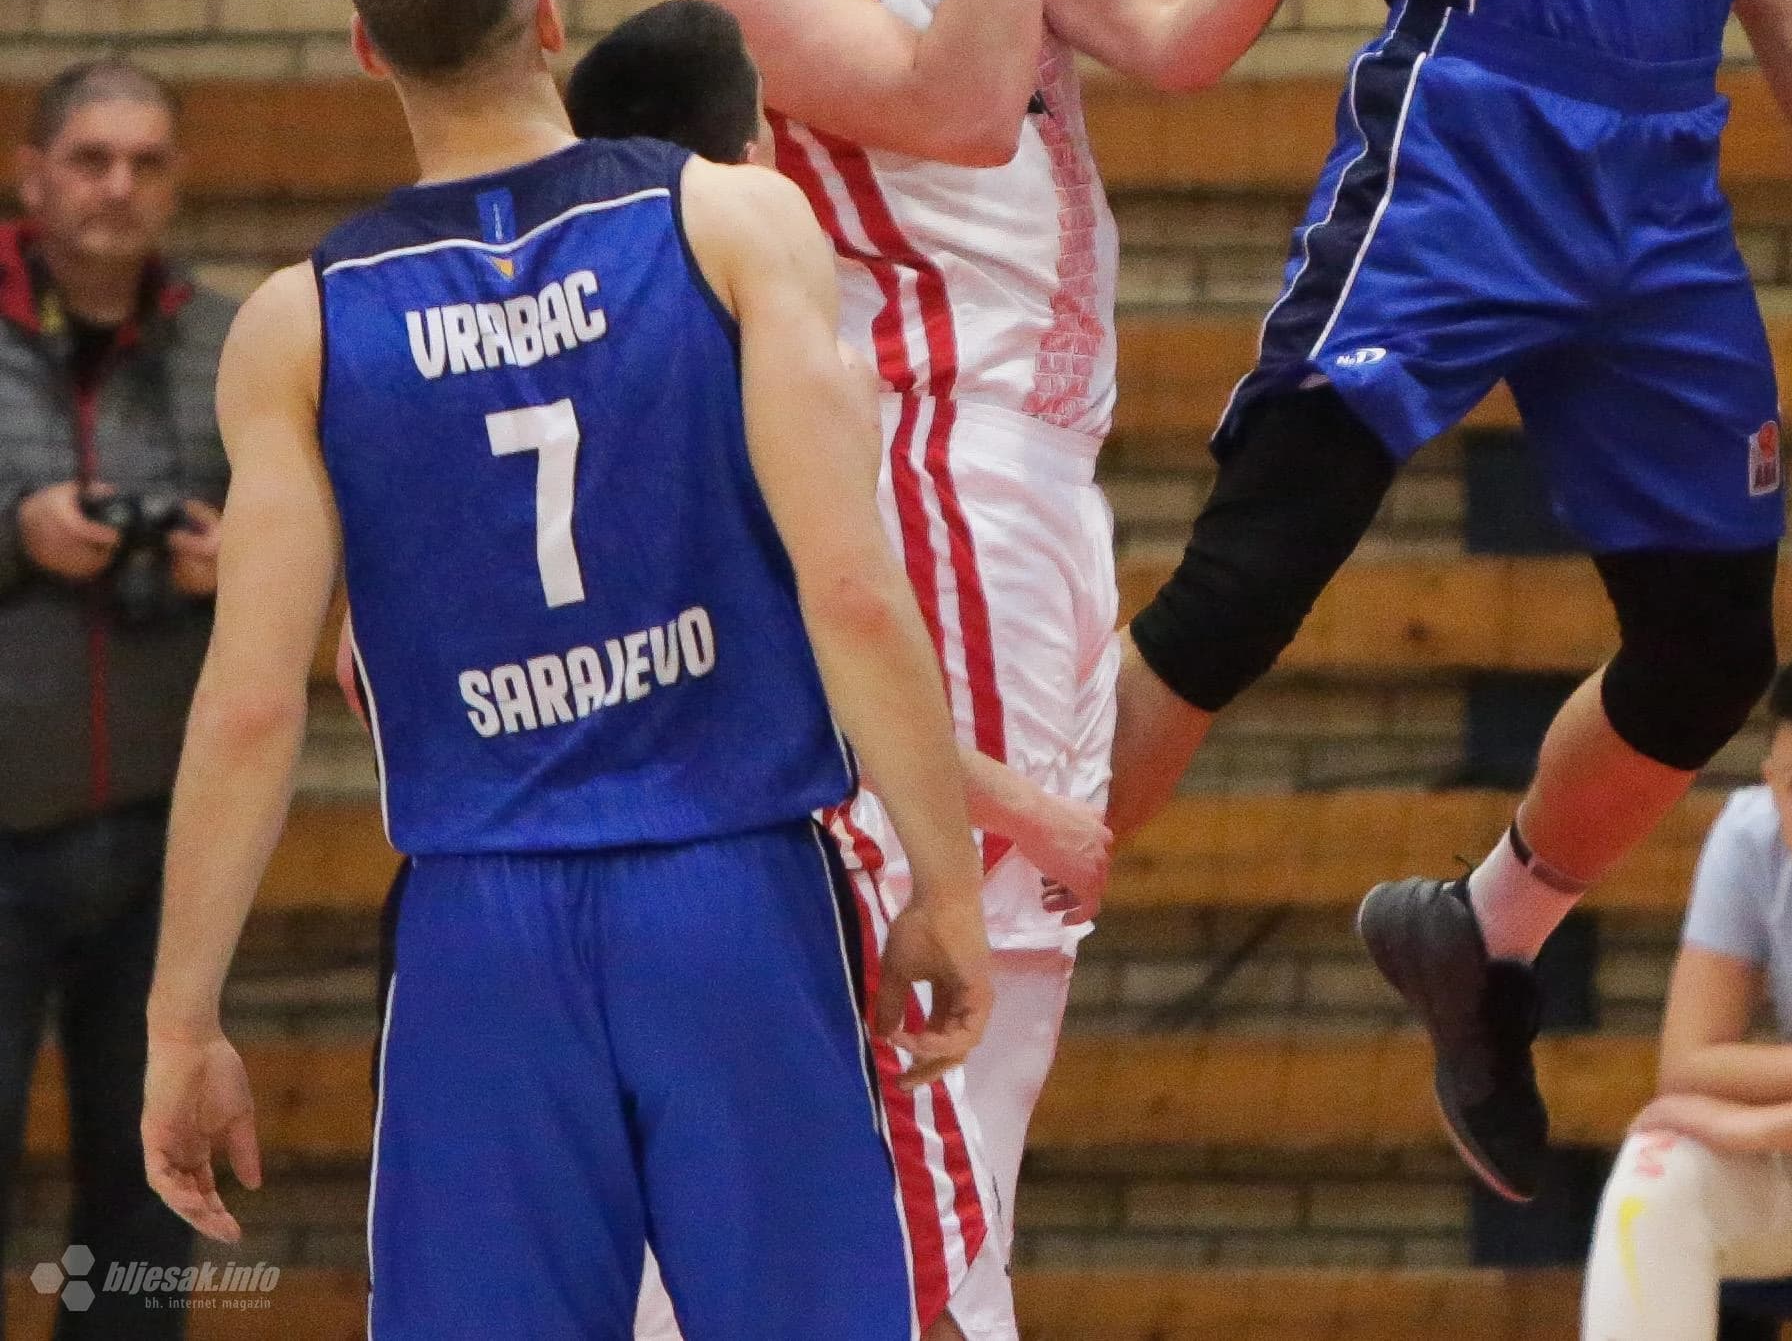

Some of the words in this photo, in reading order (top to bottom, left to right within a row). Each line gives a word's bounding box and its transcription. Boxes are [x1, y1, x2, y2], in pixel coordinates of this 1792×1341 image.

[405, 268, 607, 380] VRABAC
[484, 397, 585, 609] 7
[458, 606, 717, 738] SARAJEVO
